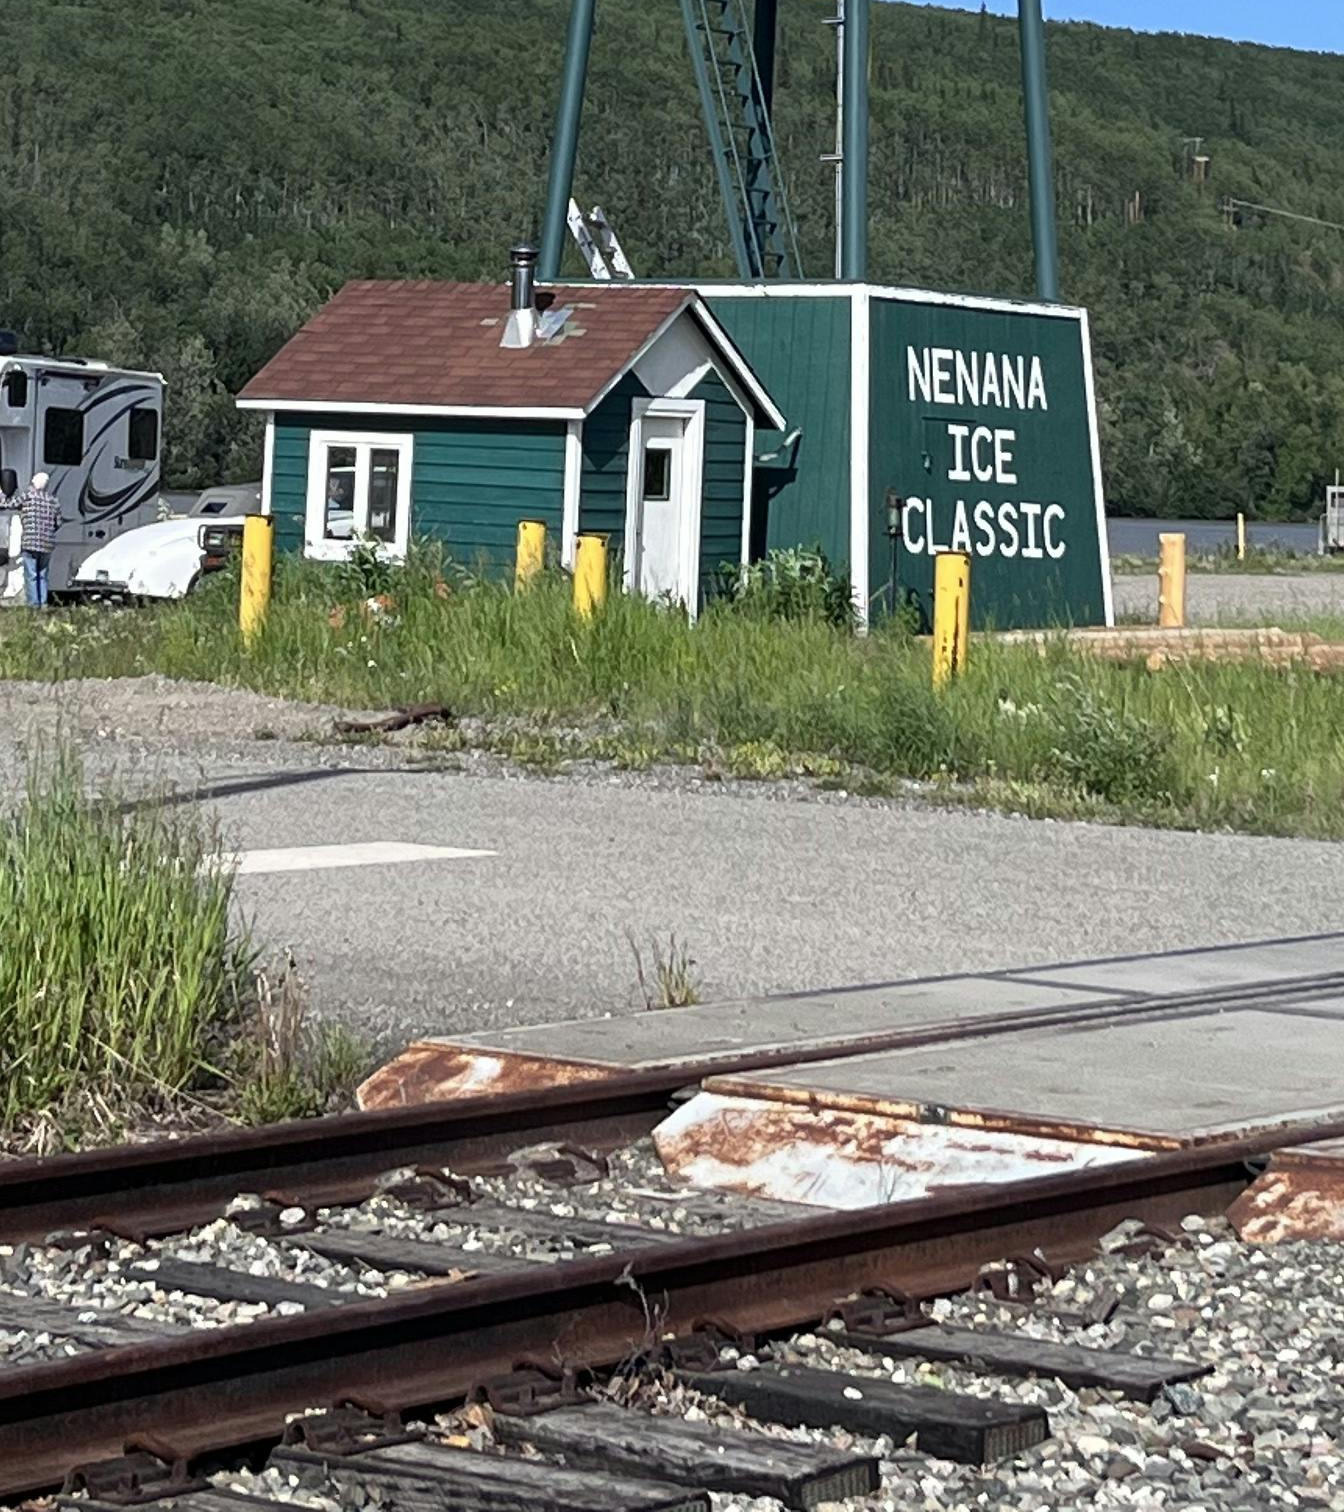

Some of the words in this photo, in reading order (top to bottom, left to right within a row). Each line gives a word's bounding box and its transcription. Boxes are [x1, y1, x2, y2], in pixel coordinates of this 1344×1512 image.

[907, 346, 1048, 411] NENANA
[947, 424, 1018, 485] ICE
[901, 496, 1066, 559] CLASSIC
